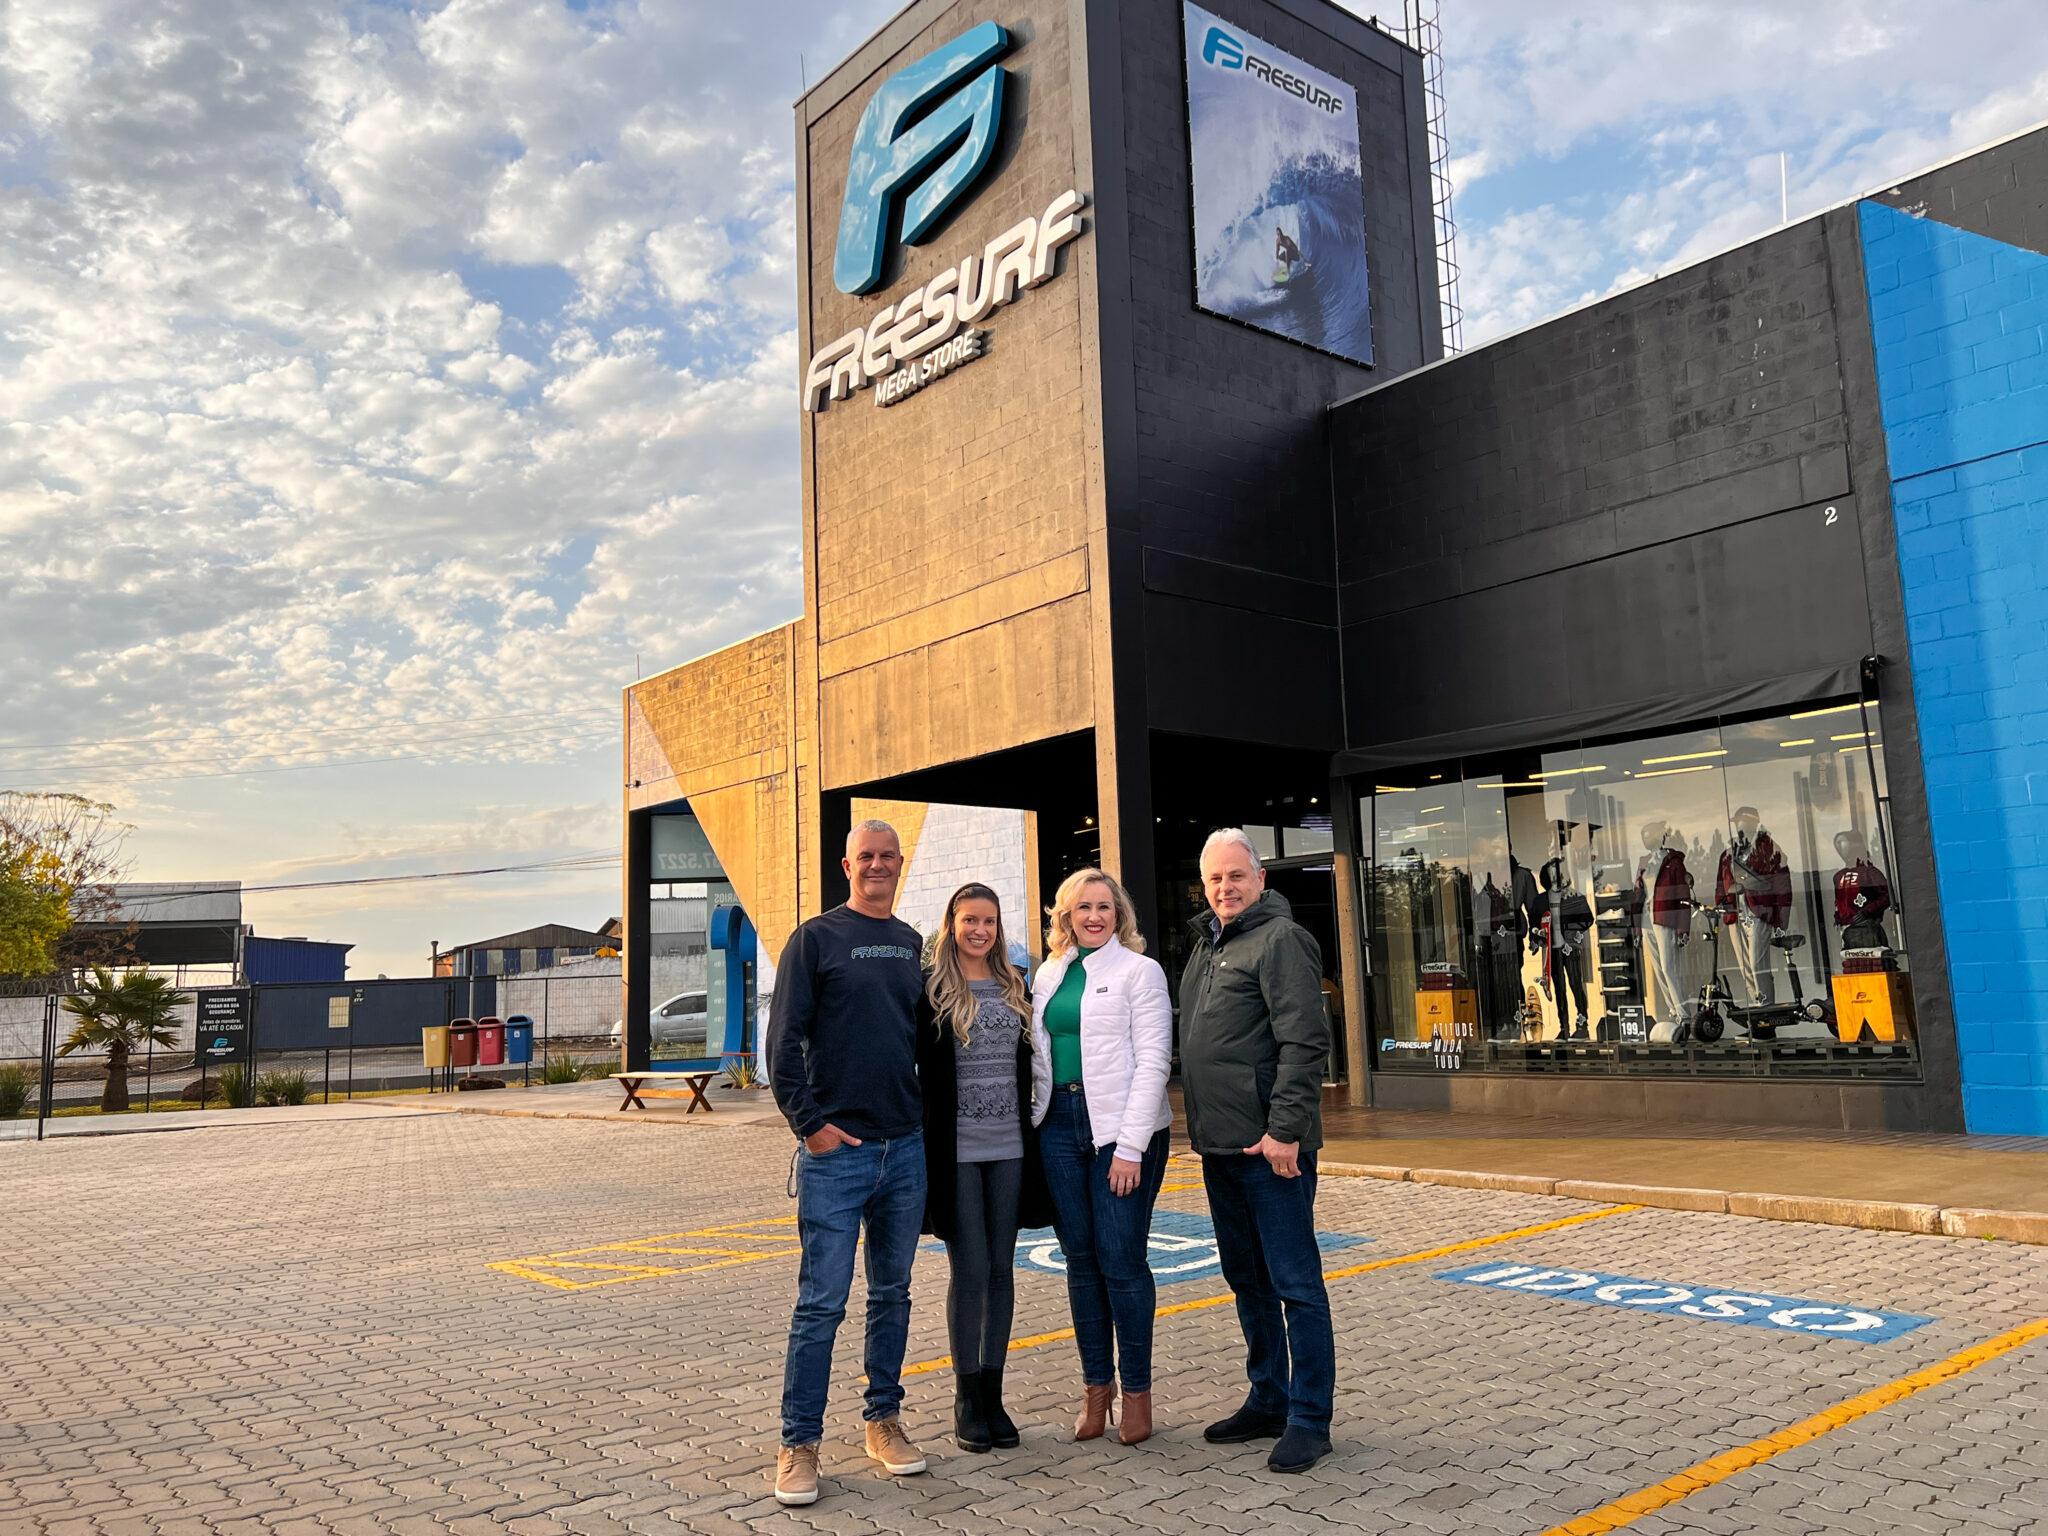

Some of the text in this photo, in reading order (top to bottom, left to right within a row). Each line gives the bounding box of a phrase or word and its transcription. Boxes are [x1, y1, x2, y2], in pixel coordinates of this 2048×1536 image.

[1245, 55, 1343, 114] FREESURF
[802, 189, 1084, 412] FREESURF
[874, 328, 981, 407] MEGA STORE
[1824, 506, 1838, 526] 2
[851, 945, 914, 960] FREESURF
[1433, 1022, 1474, 1037] ATITUDE
[1395, 1041, 1433, 1050] FREESURF
[1433, 1038, 1462, 1053] MUDA
[1434, 1055, 1461, 1069] TUDO
[1464, 1266, 1887, 1332] IDOSO
